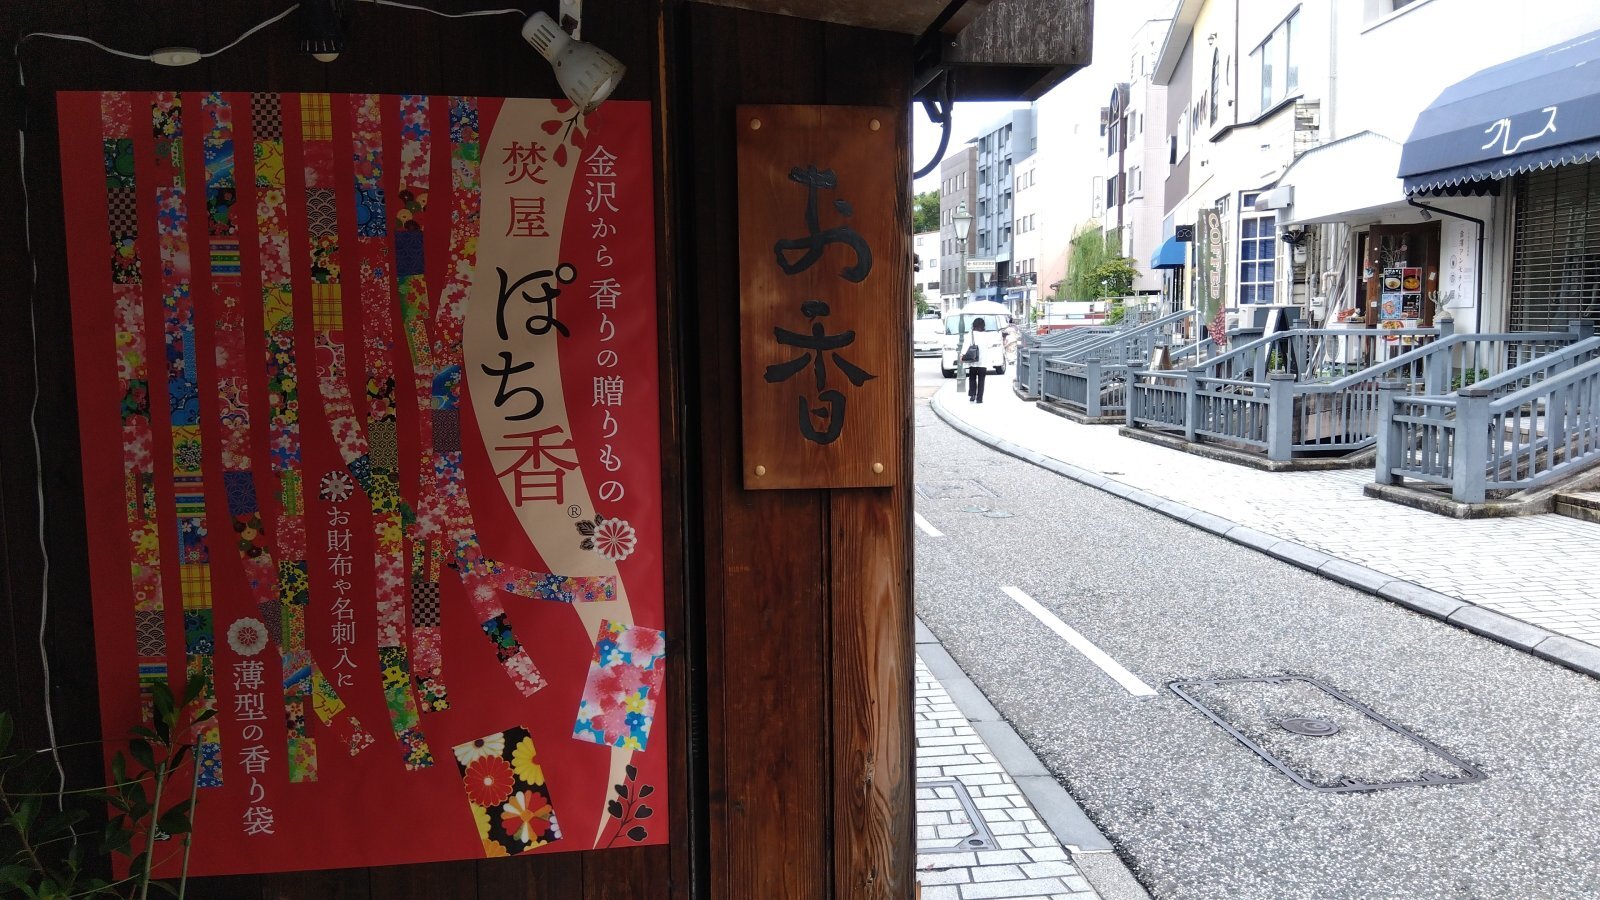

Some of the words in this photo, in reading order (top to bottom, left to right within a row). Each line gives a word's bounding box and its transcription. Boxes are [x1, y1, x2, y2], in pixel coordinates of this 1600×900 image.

[502, 141, 550, 238] 焚屋
[584, 144, 626, 503] 金沢から香りの贈りもの
[762, 165, 879, 446] お香
[326, 505, 358, 688] お財布や名刺入に
[232, 660, 276, 837] 薄型の香り袋
